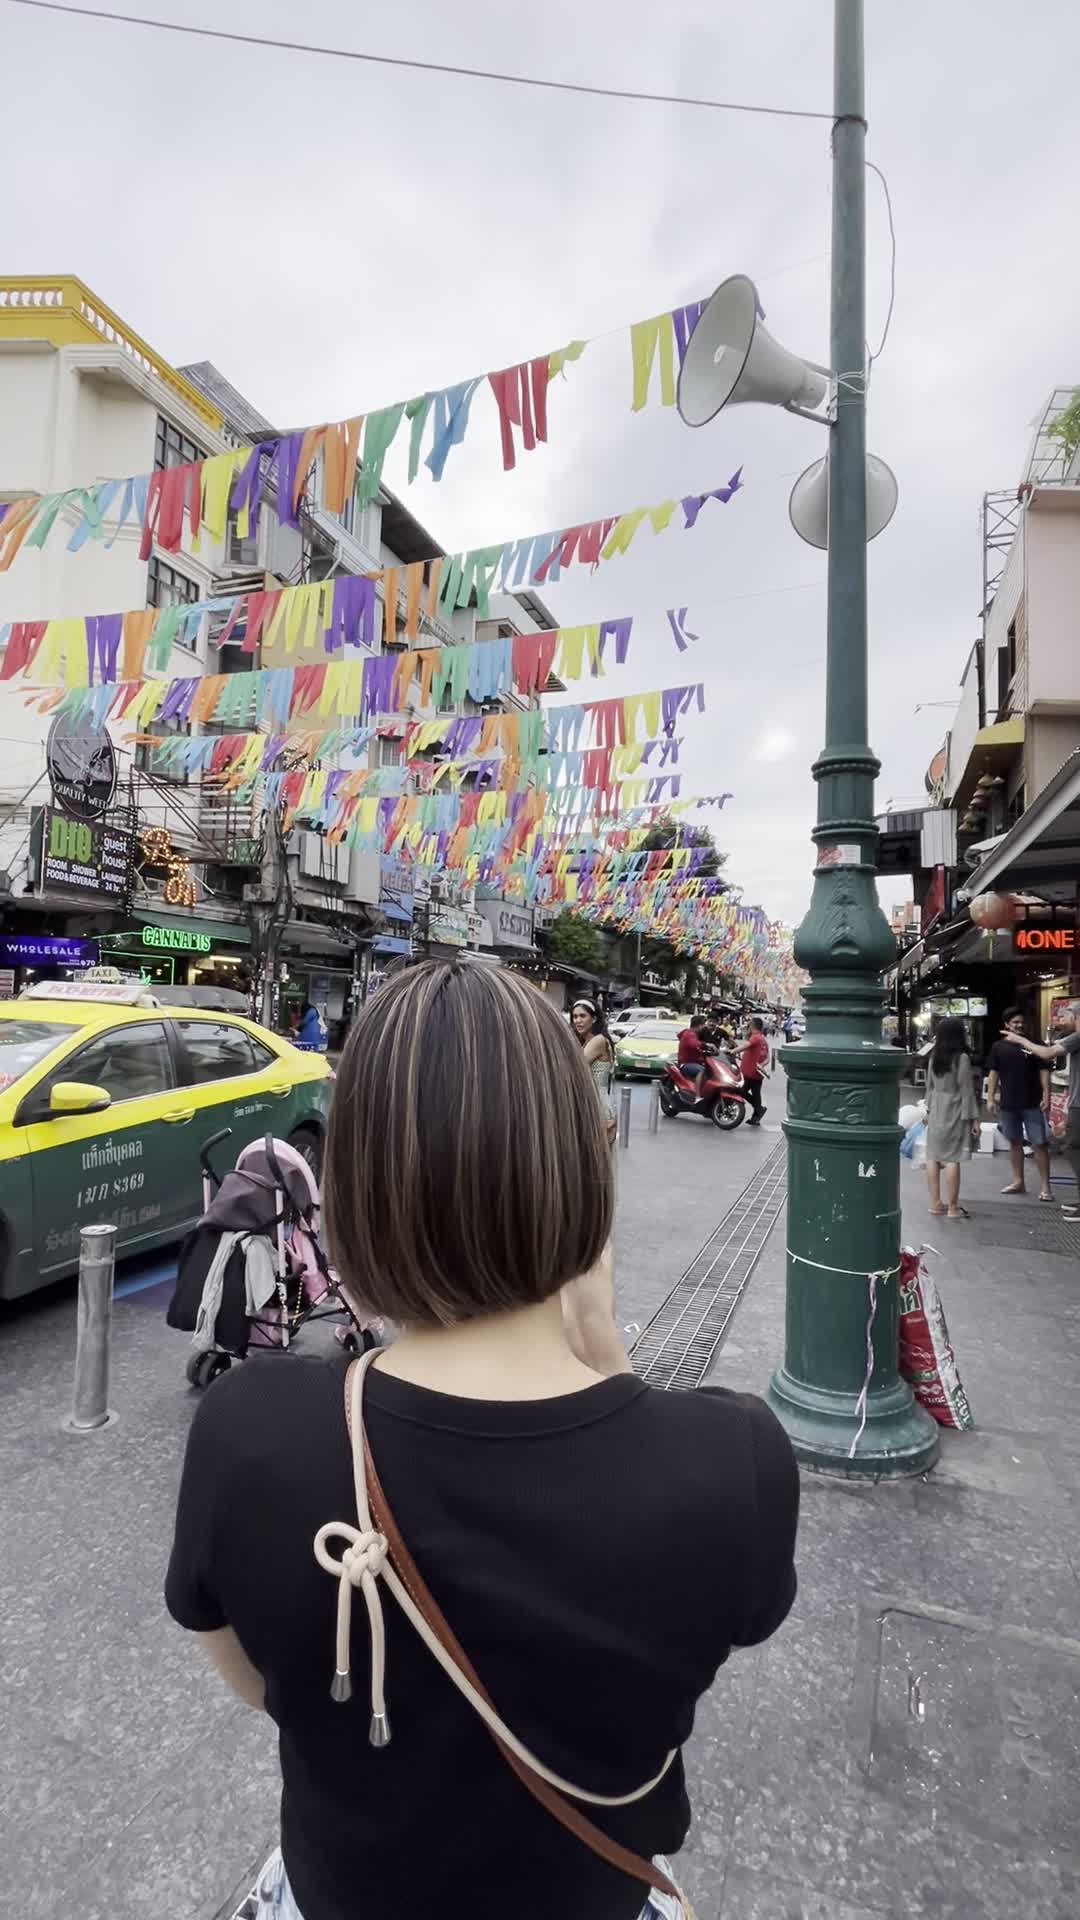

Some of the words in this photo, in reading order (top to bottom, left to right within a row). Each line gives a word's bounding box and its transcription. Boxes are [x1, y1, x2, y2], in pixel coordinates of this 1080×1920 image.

[53, 782, 87, 802] QUALITY
[103, 837, 127, 852] guest
[47, 858, 68, 871] ROOM
[71, 863, 97, 878] SHOWER
[102, 850, 127, 870] house
[142, 925, 211, 952] CANNABIS
[6, 943, 81, 956] WHOLESALE
[91, 969, 112, 978] TAXI
[112, 1172, 145, 1197] 8369
